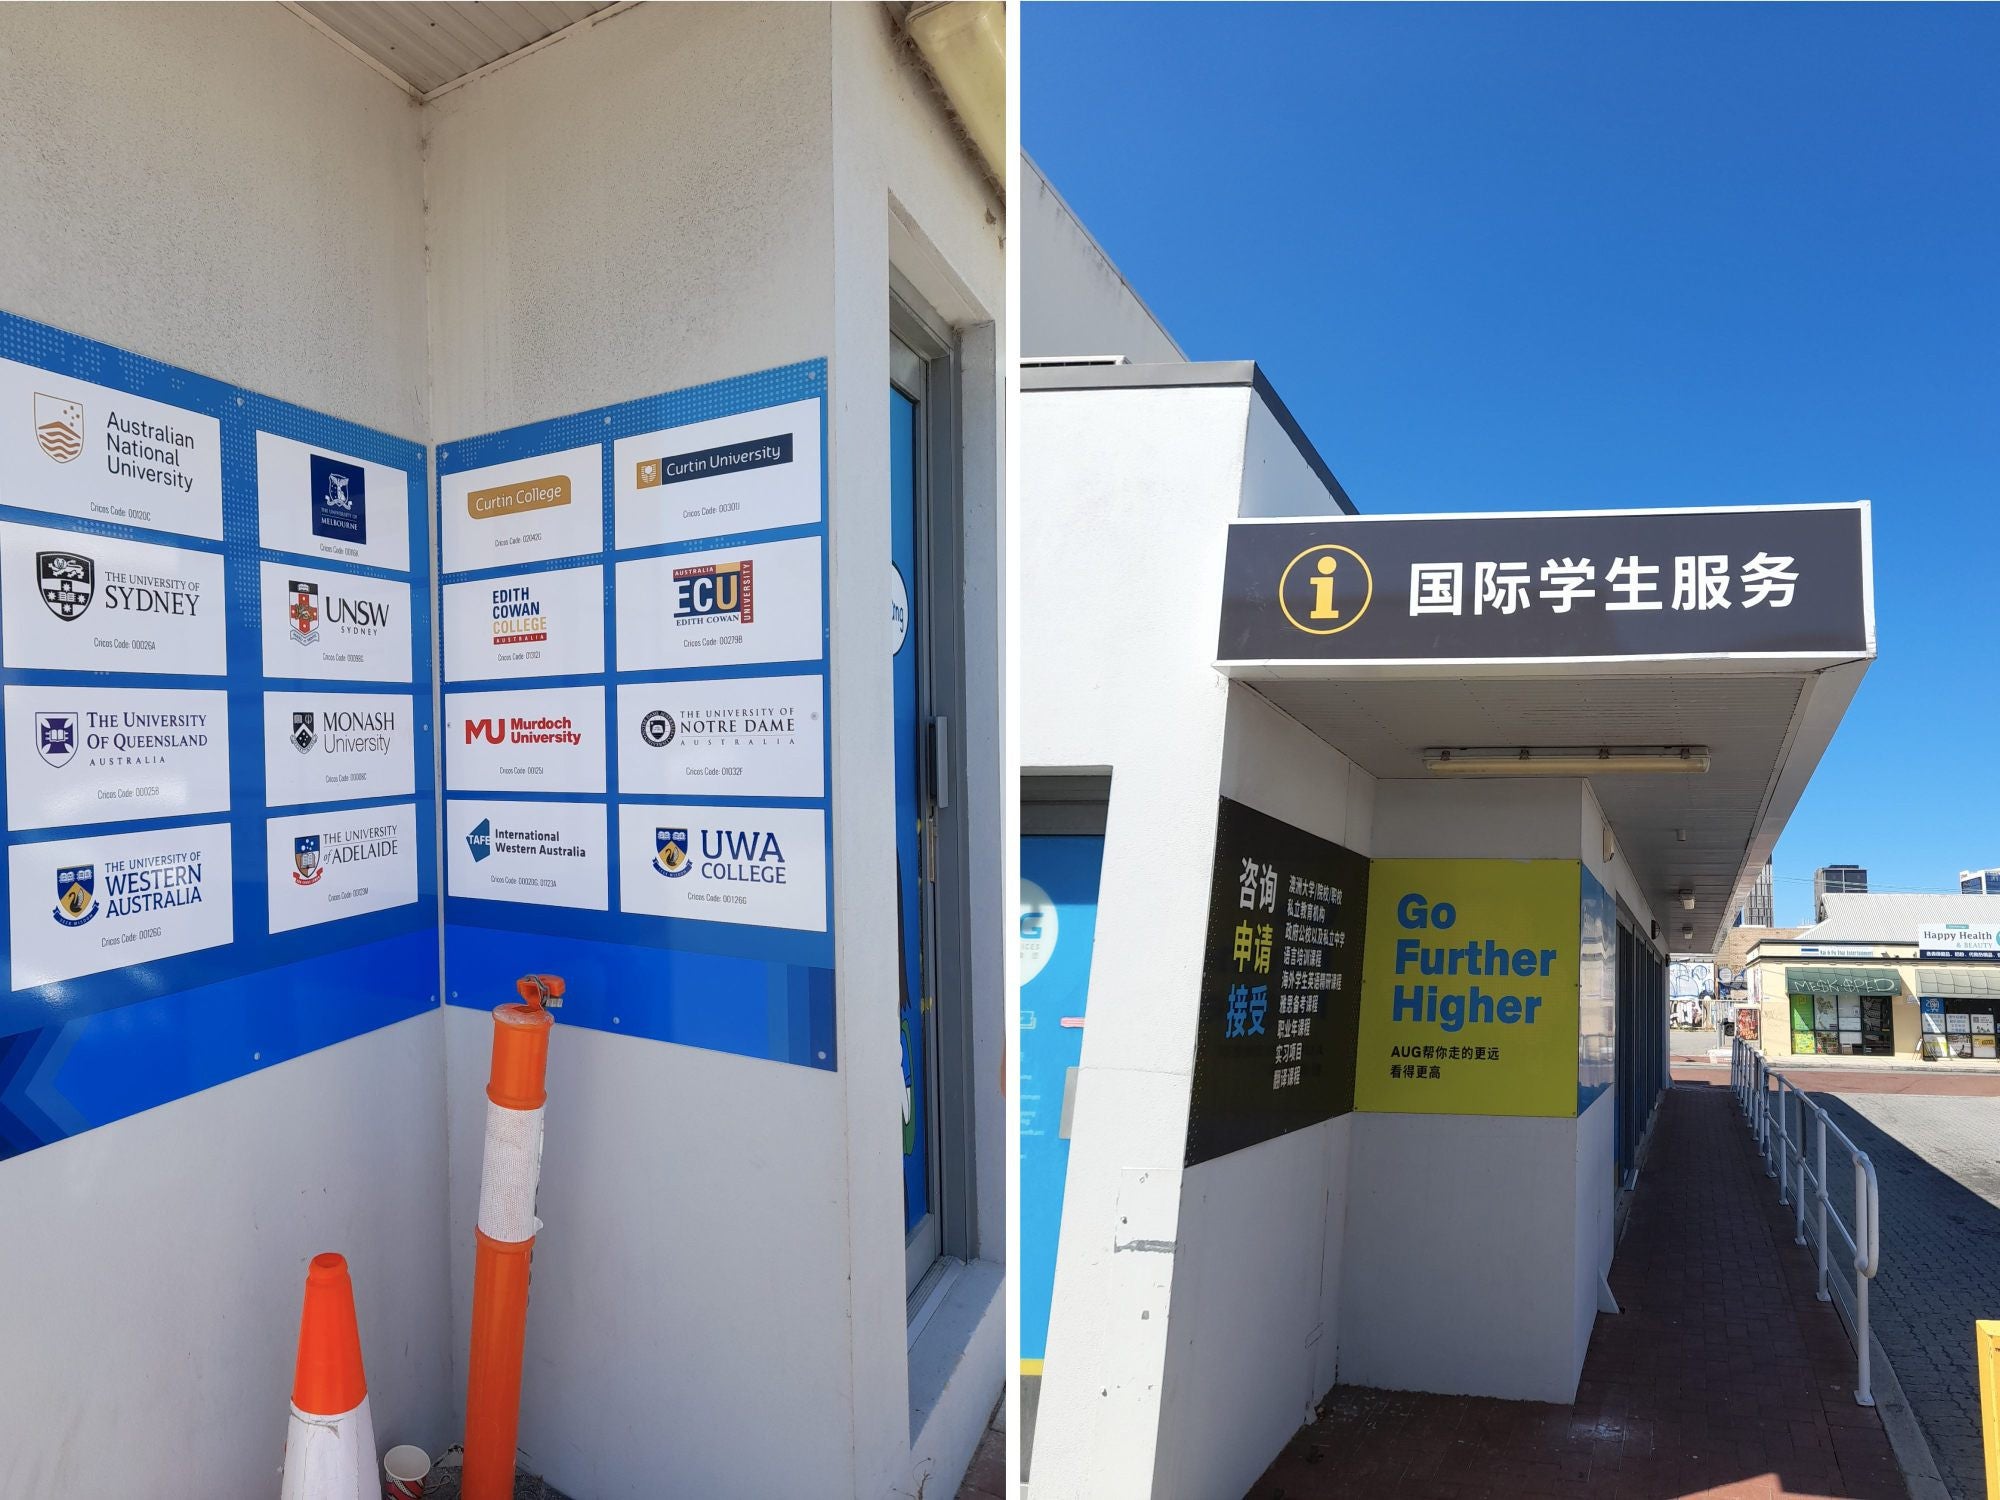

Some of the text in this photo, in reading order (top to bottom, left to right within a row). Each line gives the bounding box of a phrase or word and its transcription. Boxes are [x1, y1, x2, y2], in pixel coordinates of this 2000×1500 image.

[107, 411, 194, 449] Australian
[107, 433, 179, 467] National
[666, 446, 781, 477] Curtin University
[108, 455, 193, 492] University
[476, 486, 562, 512] Curtin College
[91, 501, 109, 514] Cricos
[129, 509, 151, 521] 00120C
[683, 510, 701, 519] Cricos
[321, 517, 358, 530] MELBOURNE
[105, 571, 200, 591] THE UNIVERSITY OF
[675, 566, 714, 577] AUSTRALIA
[673, 575, 738, 613] ECU
[743, 563, 751, 621] UNIVERSITY
[1409, 551, 1800, 617] 国际学生服务
[105, 585, 200, 616] SYDNEY
[492, 587, 529, 604] EDITH
[326, 596, 389, 627] UNSW
[492, 601, 540, 619] COWAN
[493, 617, 547, 635] COLLEGE
[676, 614, 740, 627] EDITH COWAN
[341, 626, 378, 636] SYDNEY
[496, 634, 544, 643] AUSTRALIA
[94, 637, 112, 648] Cricos
[132, 640, 156, 650] 00026A
[684, 639, 701, 648] Cricos
[719, 635, 743, 645] 00279B
[323, 712, 394, 731] MONASH
[680, 707, 795, 718] THE UNIVERSITY OF
[465, 717, 571, 745] MU Murdoch
[680, 718, 795, 734] NOTRE DAME
[324, 734, 391, 755] University
[511, 731, 581, 745] University
[89, 756, 166, 767] AUSTRALIA
[686, 767, 704, 776] Cricos
[98, 790, 117, 800] Cricos
[324, 825, 397, 844] THE UNIVERSITY
[468, 835, 490, 845] TAFE
[496, 829, 559, 842] International
[324, 840, 398, 864] of ADELAIDE
[496, 842, 586, 858] Western Australia
[701, 830, 785, 863] UWA
[105, 851, 202, 873] THE UNIVERSITY OF
[105, 863, 202, 896] WESTERN
[701, 862, 787, 884] COLLEGE
[1239, 857, 1278, 914] 咨询
[106, 886, 202, 918] AUSTRALIA
[687, 892, 705, 902] Cricos
[723, 895, 747, 905] 00126G
[1287, 898, 1325, 924] 私立教育机构
[1397, 893, 1456, 930] Go
[101, 936, 120, 948] Cricos
[1285, 922, 1345, 948] 政府公校以及私立中学
[1924, 931, 1992, 941] Happy Health
[1233, 919, 1274, 974] 申请
[1284, 946, 1322, 968] 语言培训课程
[1395, 938, 1557, 977] Further
[1225, 984, 1268, 1039] 接受
[1279, 994, 1319, 1014] 雅思备考课程
[1392, 985, 1542, 1033] Higher
[1275, 1042, 1303, 1064] 实习项目
[1391, 1045, 1500, 1061] AUG帮你走的更远
[1390, 1064, 1441, 1080] 看得更高
